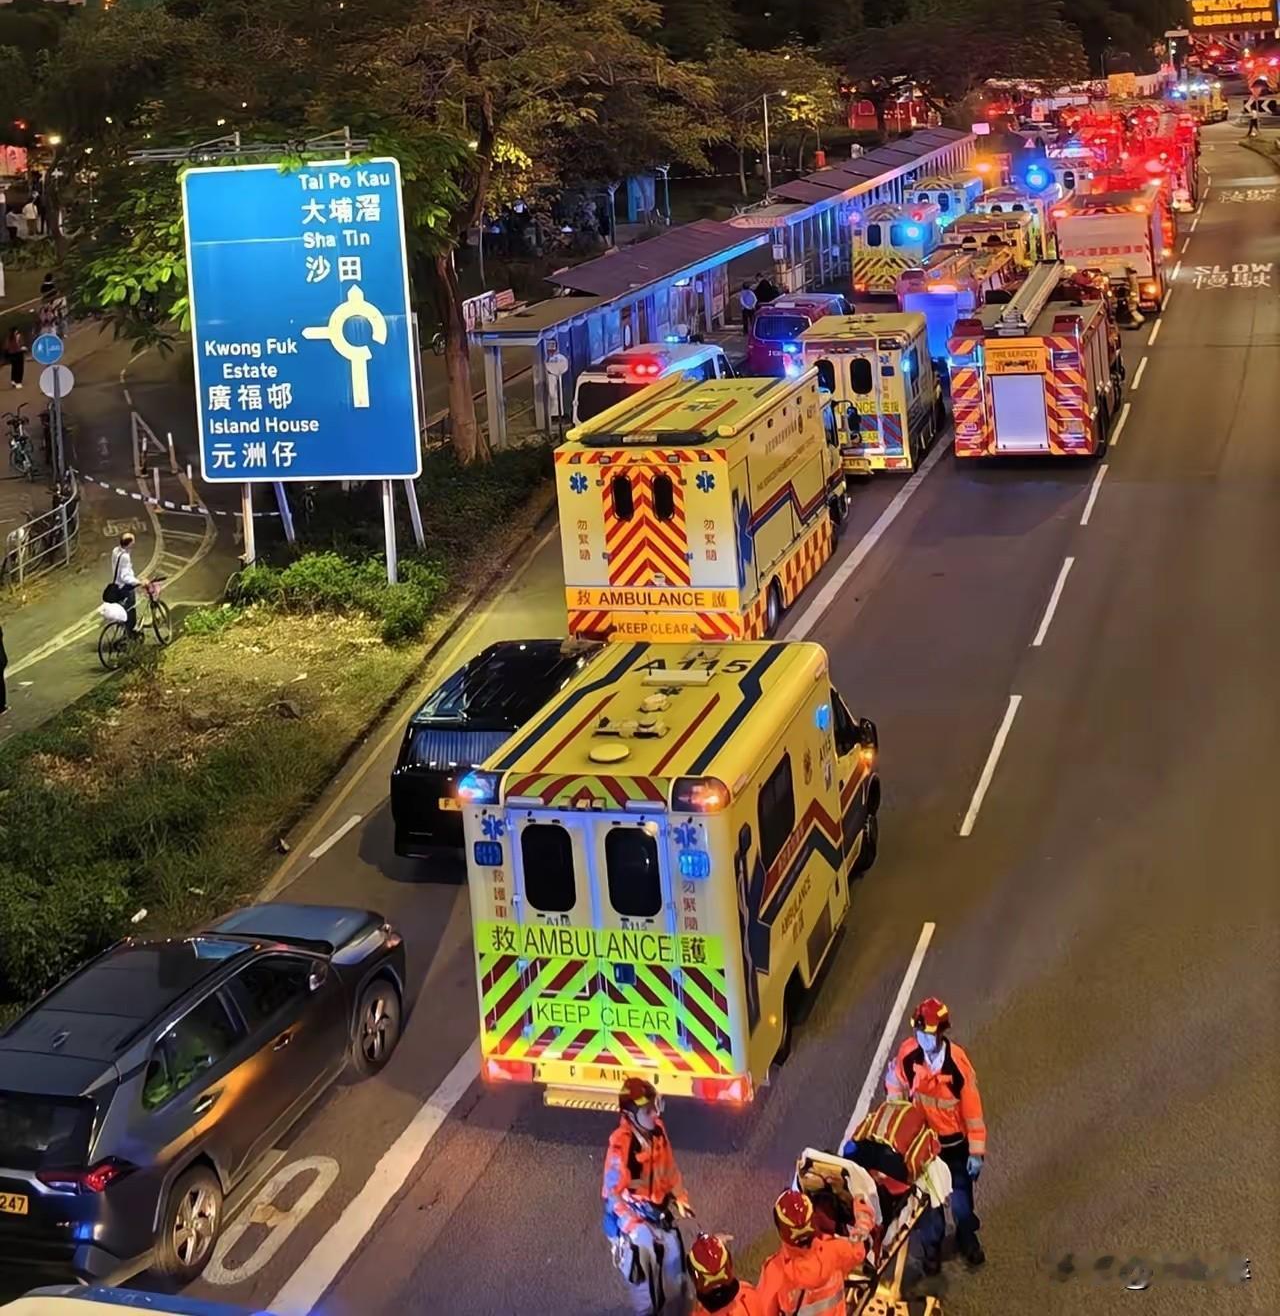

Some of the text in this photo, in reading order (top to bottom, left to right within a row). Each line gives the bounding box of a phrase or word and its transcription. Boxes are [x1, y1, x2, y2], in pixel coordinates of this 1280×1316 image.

[298, 170, 390, 190] Tai Po Kau
[301, 193, 381, 225] 大埔滘
[303, 230, 370, 249] Sha Tin
[305, 256, 362, 283] 沙田
[205, 338, 298, 358] Kwong Fuk
[223, 363, 278, 379] Estate
[208, 383, 292, 411] 廣福邨
[209, 417, 320, 434] Island House
[211, 441, 298, 469] 元洲仔
[598, 591, 705, 607] AMBULANCE
[618, 623, 689, 635] KEEP CLEAR
[491, 925, 708, 964] 救 AMBULANCE 護
[536, 1002, 671, 1030] KEEP CLEAR
[0, 1194, 26, 1212] 247
